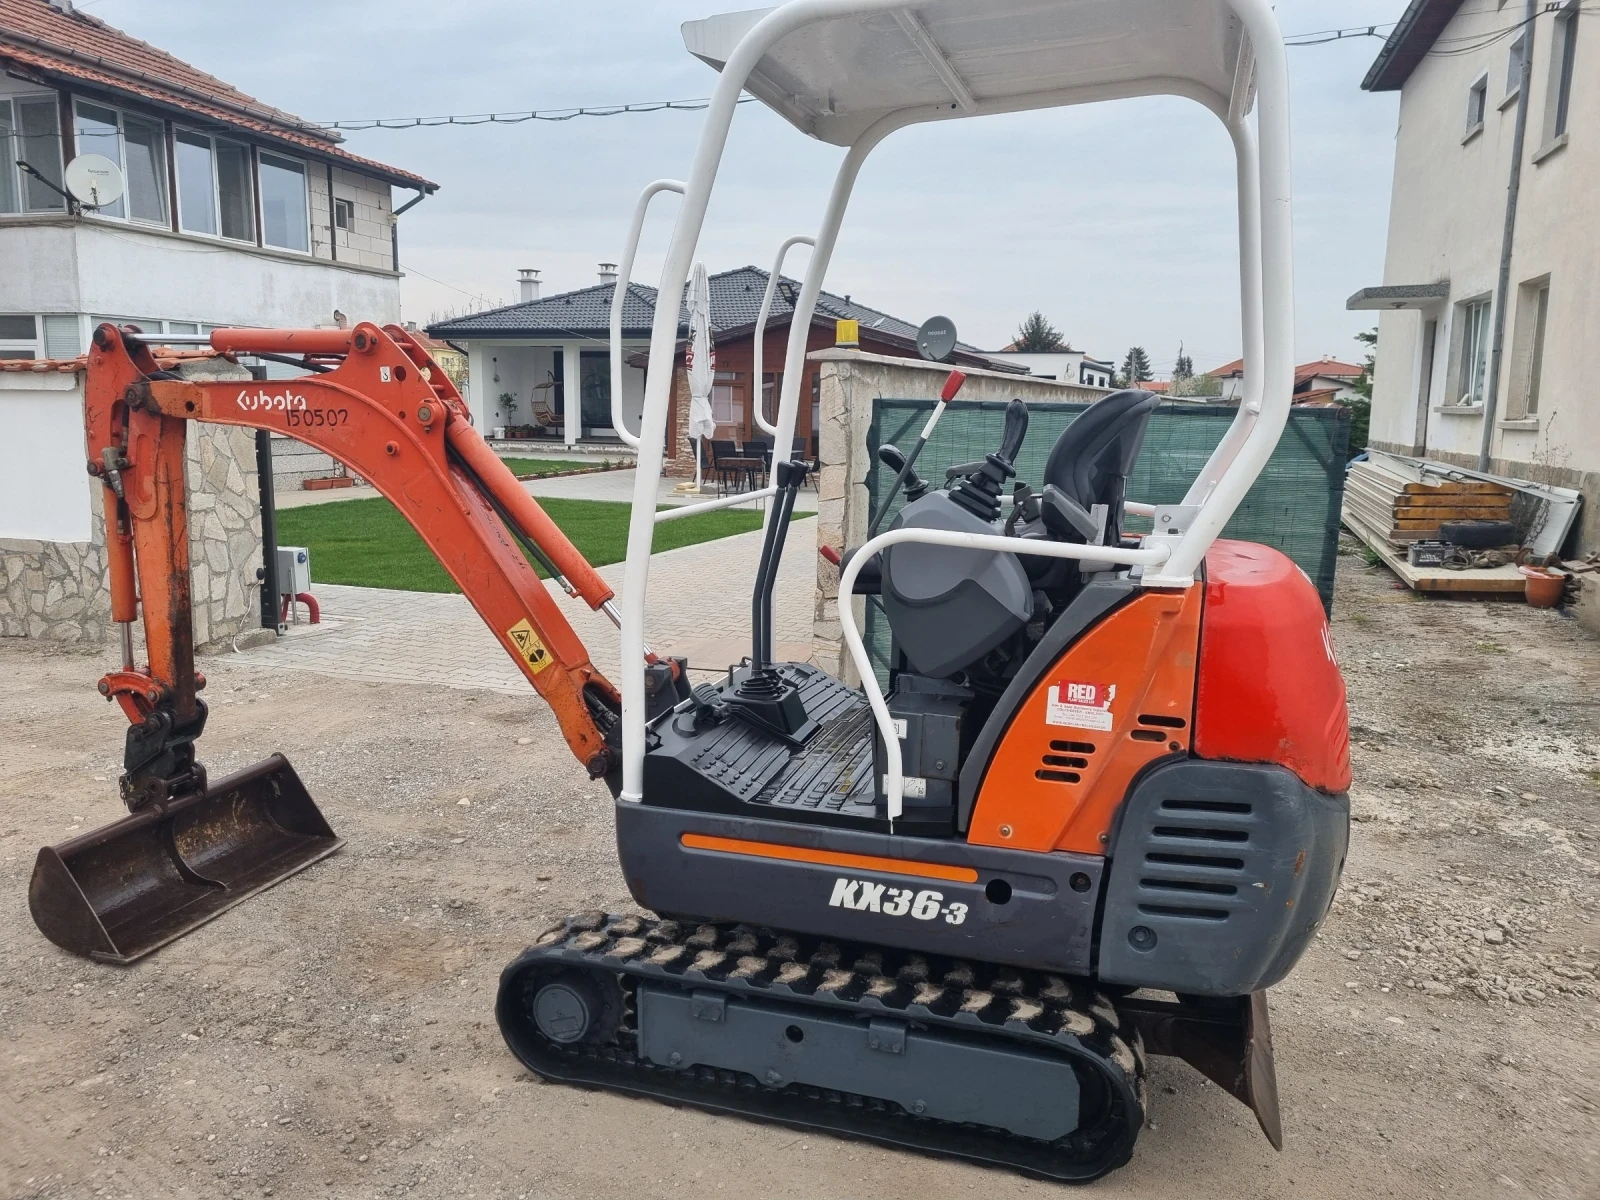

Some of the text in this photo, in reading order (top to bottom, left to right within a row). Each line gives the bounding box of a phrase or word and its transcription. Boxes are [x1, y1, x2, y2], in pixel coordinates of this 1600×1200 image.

[236, 390, 307, 411] Kubota
[1067, 683, 1096, 700] RED
[828, 878, 969, 925] KX36-3
